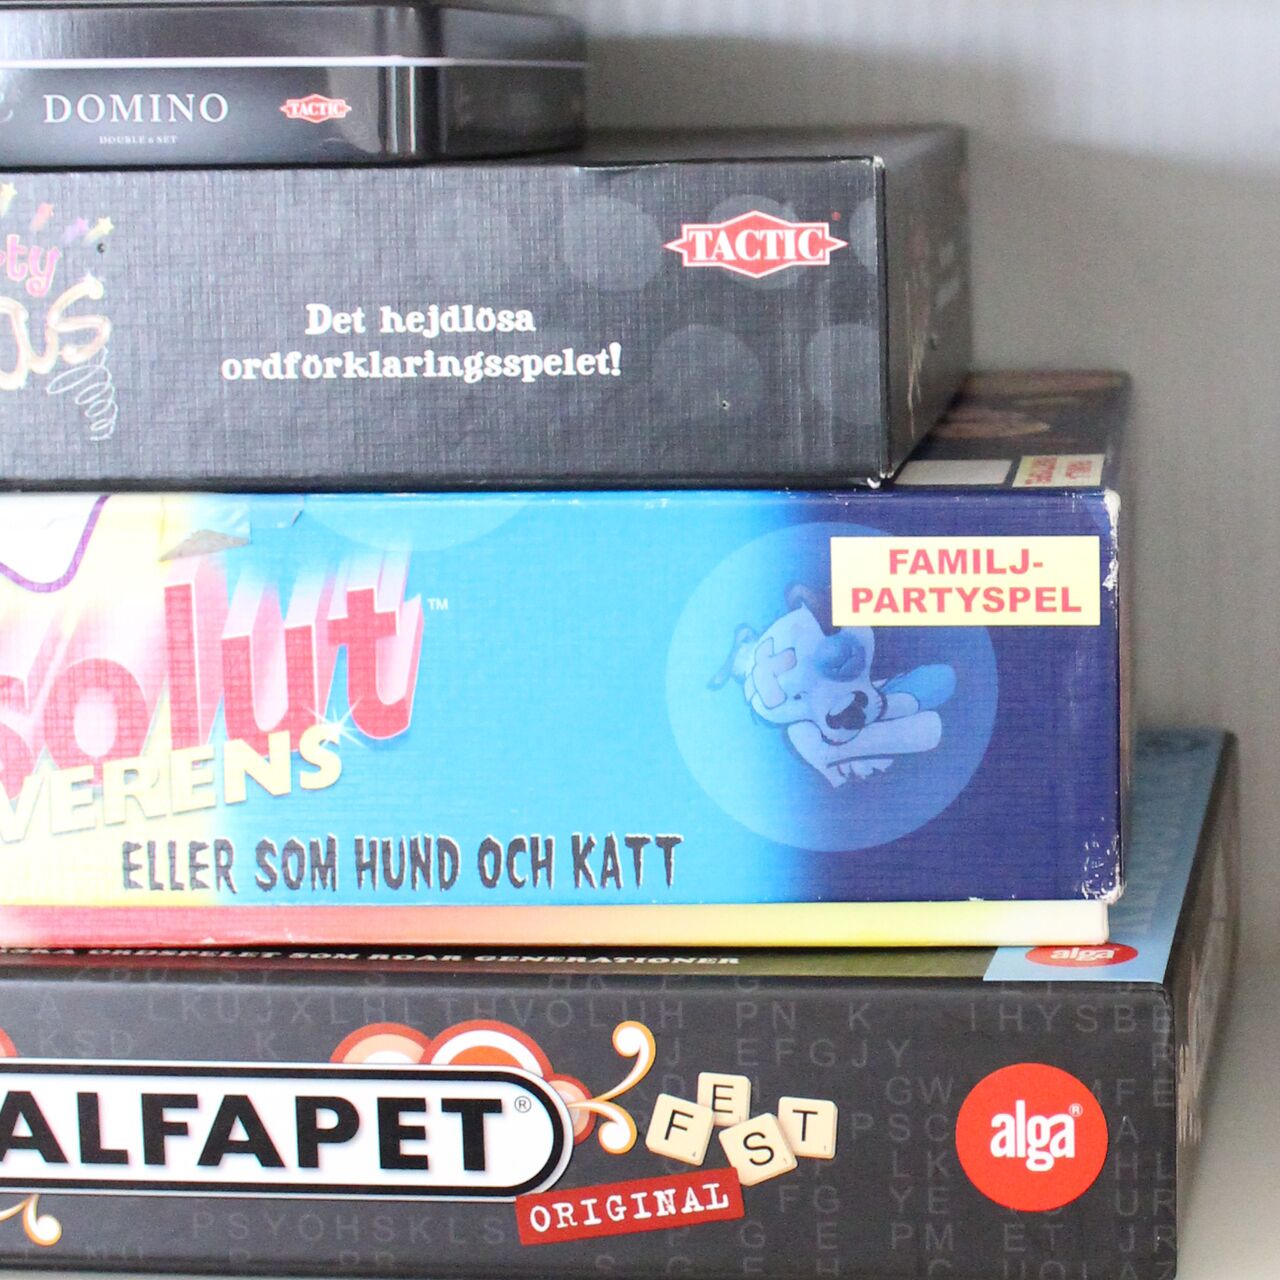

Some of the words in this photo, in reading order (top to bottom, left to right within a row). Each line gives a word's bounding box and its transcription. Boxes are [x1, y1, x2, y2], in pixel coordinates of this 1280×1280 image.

[43, 93, 229, 124] DOMINO
[288, 100, 344, 118] TACTIC
[99, 135, 145, 145] DOUBLE
[686, 227, 828, 264] TACTIC
[0, 234, 62, 298] ty
[304, 303, 366, 337] Det
[379, 302, 537, 339] hejdlösa
[220, 340, 624, 384] ordförklaringsspelet!
[888, 547, 1044, 577] FAMILJ-
[850, 585, 1083, 615] PARTYSPEL
[121, 836, 238, 894] ELLER
[255, 834, 339, 893] SOM
[354, 833, 462, 892] HUND
[477, 834, 556, 892] OCH
[571, 831, 684, 891] KATT
[290, 951, 360, 961] SOM
[370, 952, 463, 962] ROAR
[475, 954, 740, 966] GENERATIONER
[1049, 945, 1115, 964] alga
[0, 1090, 504, 1173] ALFAPET
[662, 1083, 819, 1167] FEST
[989, 1099, 1077, 1173] alga
[529, 1181, 729, 1233] ORIGINAL
